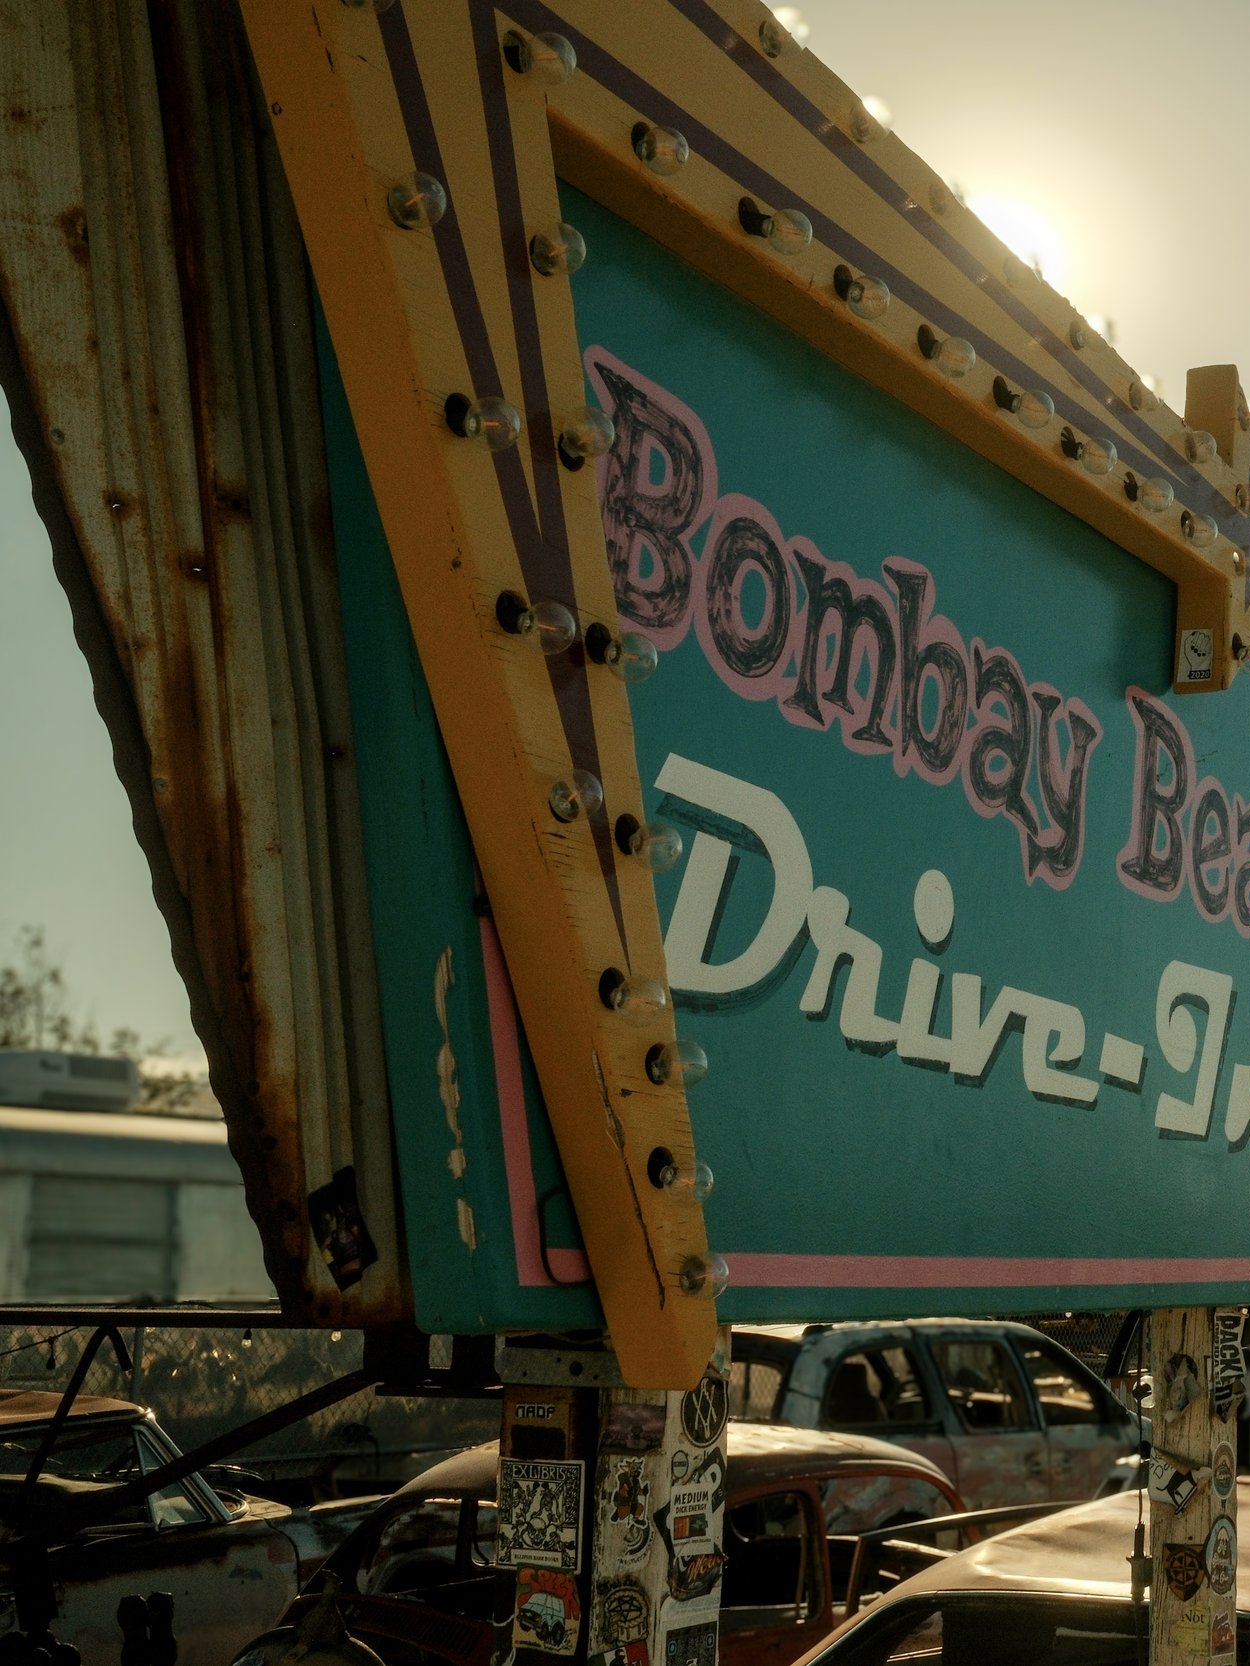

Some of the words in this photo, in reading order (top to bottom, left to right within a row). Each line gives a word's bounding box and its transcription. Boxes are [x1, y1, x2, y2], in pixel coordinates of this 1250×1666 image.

[586, 347, 1101, 888] Bombay
[1190, 671, 1210, 679] 2020
[512, 1464, 528, 1478] EX
[529, 1465, 566, 1481] LIBRIS
[674, 1490, 709, 1506] MEDIUM
[675, 1506, 688, 1514] DICK
[688, 1503, 708, 1513] ENERGY
